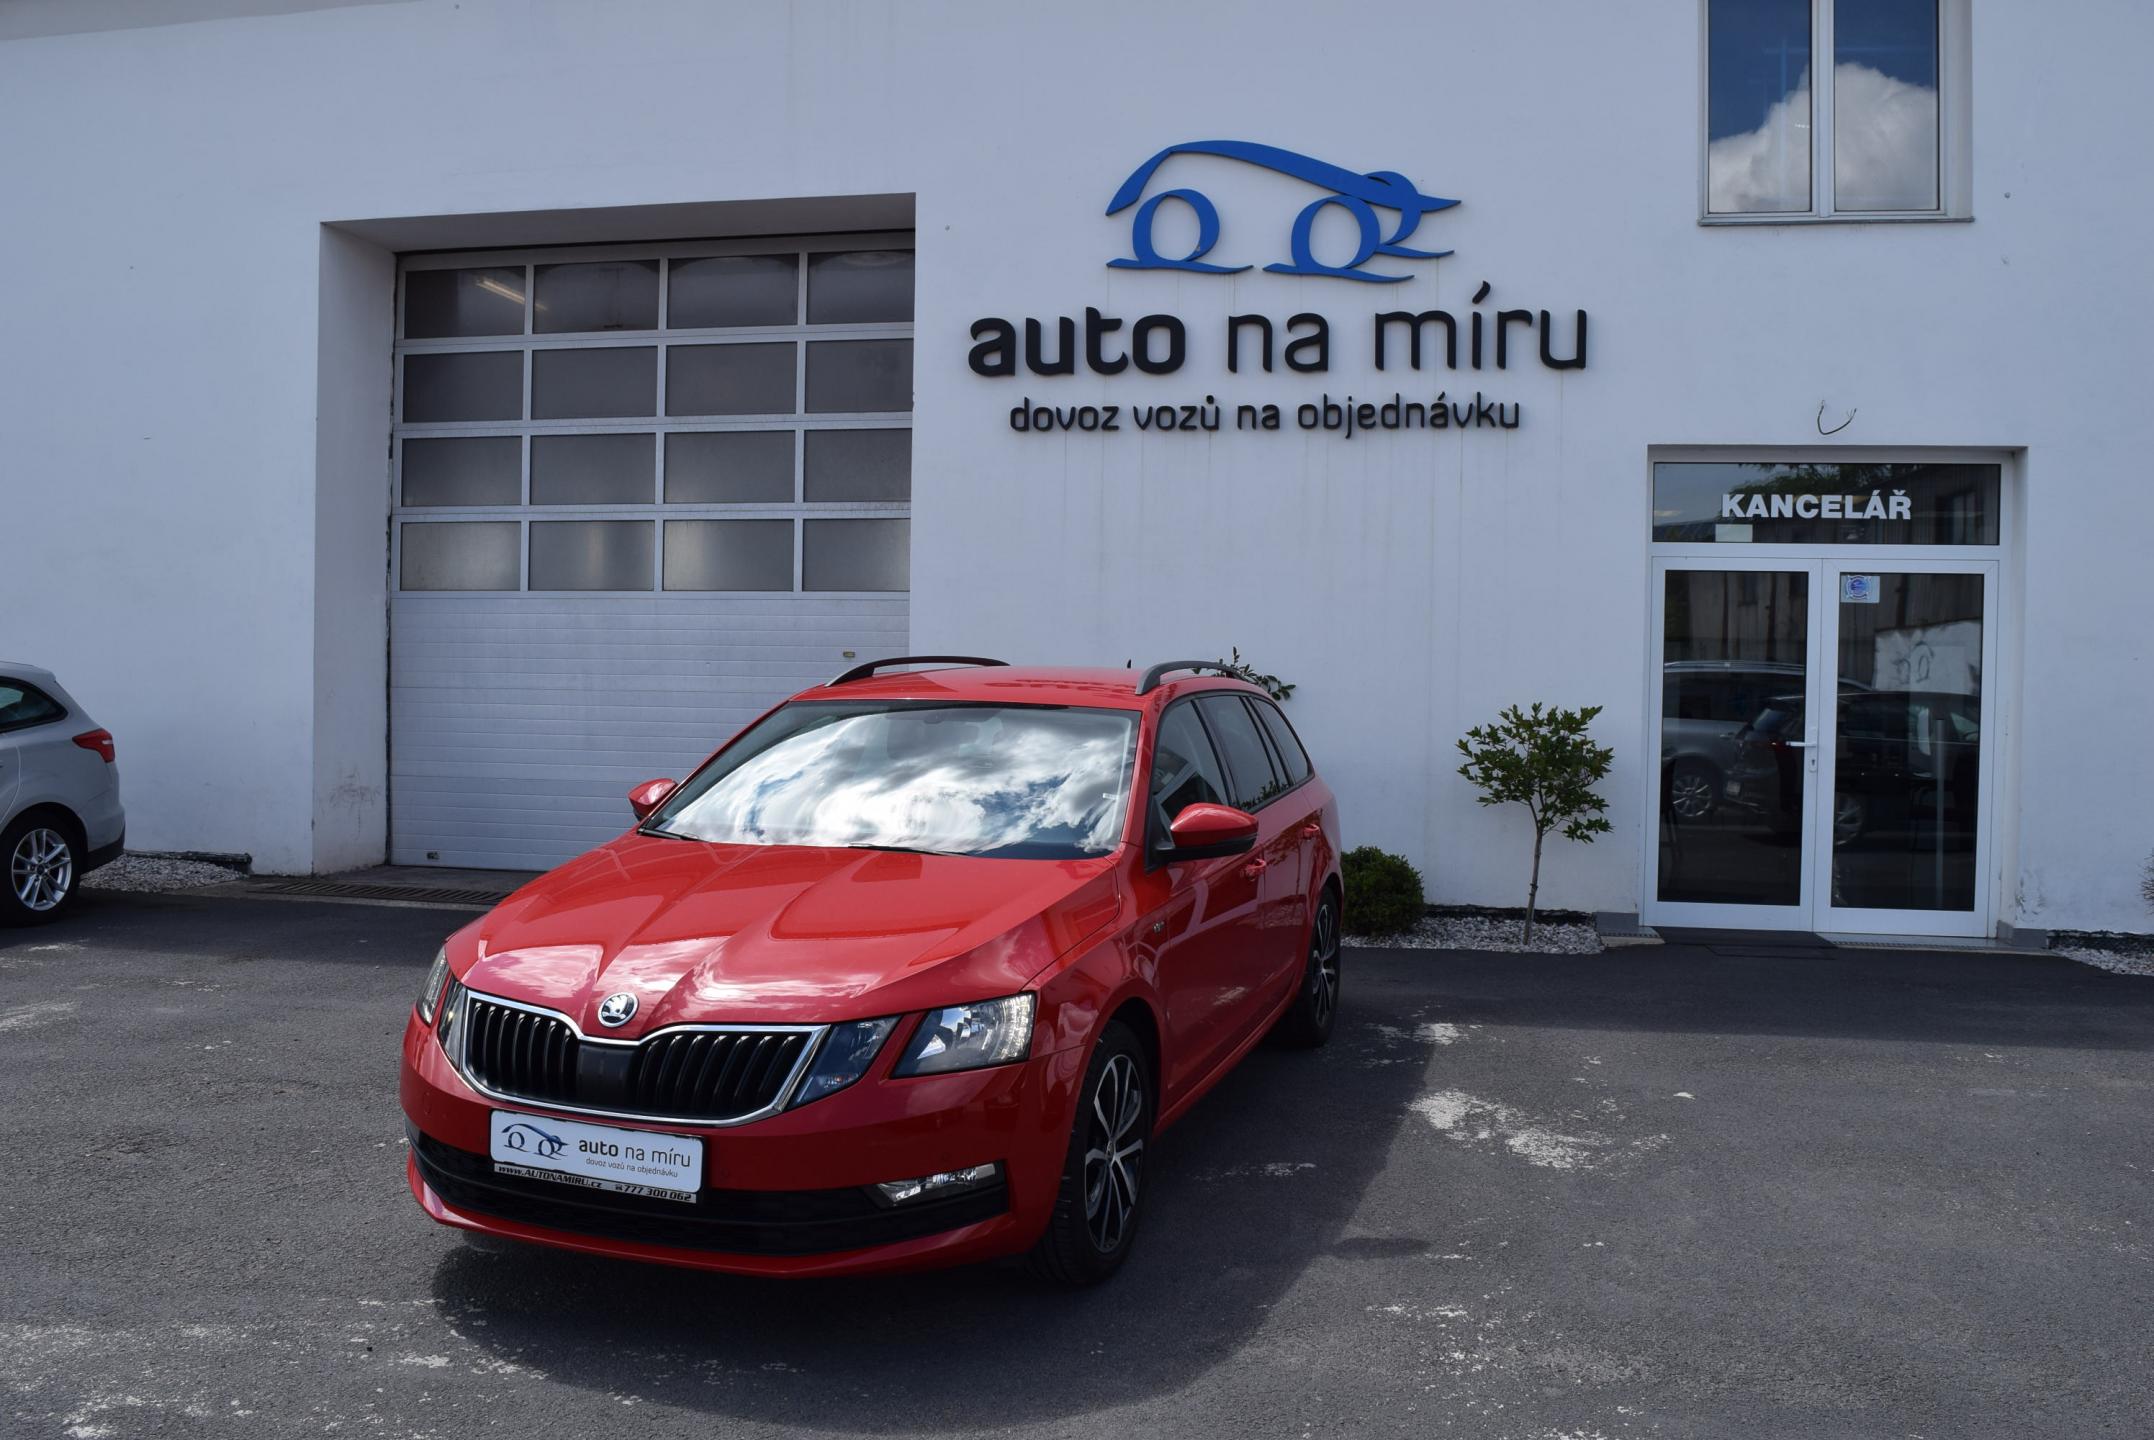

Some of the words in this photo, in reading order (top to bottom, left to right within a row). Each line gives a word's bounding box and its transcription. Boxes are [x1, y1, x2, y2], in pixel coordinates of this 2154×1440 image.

[968, 306, 1186, 377] auto
[1227, 312, 1330, 374] na
[1374, 280, 1588, 373] míru
[1010, 396, 1120, 433] dovoz
[1133, 395, 1221, 433] vozů
[1237, 404, 1281, 431] na
[1297, 392, 1520, 439] objednávku
[1722, 489, 1912, 520] KANCELÁŘ
[578, 1139, 619, 1158] auto
[625, 1146, 645, 1162] na
[651, 1147, 691, 1168] míru
[586, 1157, 607, 1168] dovoz
[608, 1160, 625, 1171] vozů
[626, 1163, 636, 1172] na
[637, 1165, 679, 1178] objednávku
[624, 1184, 644, 1194] 777
[647, 1187, 668, 1198] 300
[669, 1190, 692, 1201] 062
